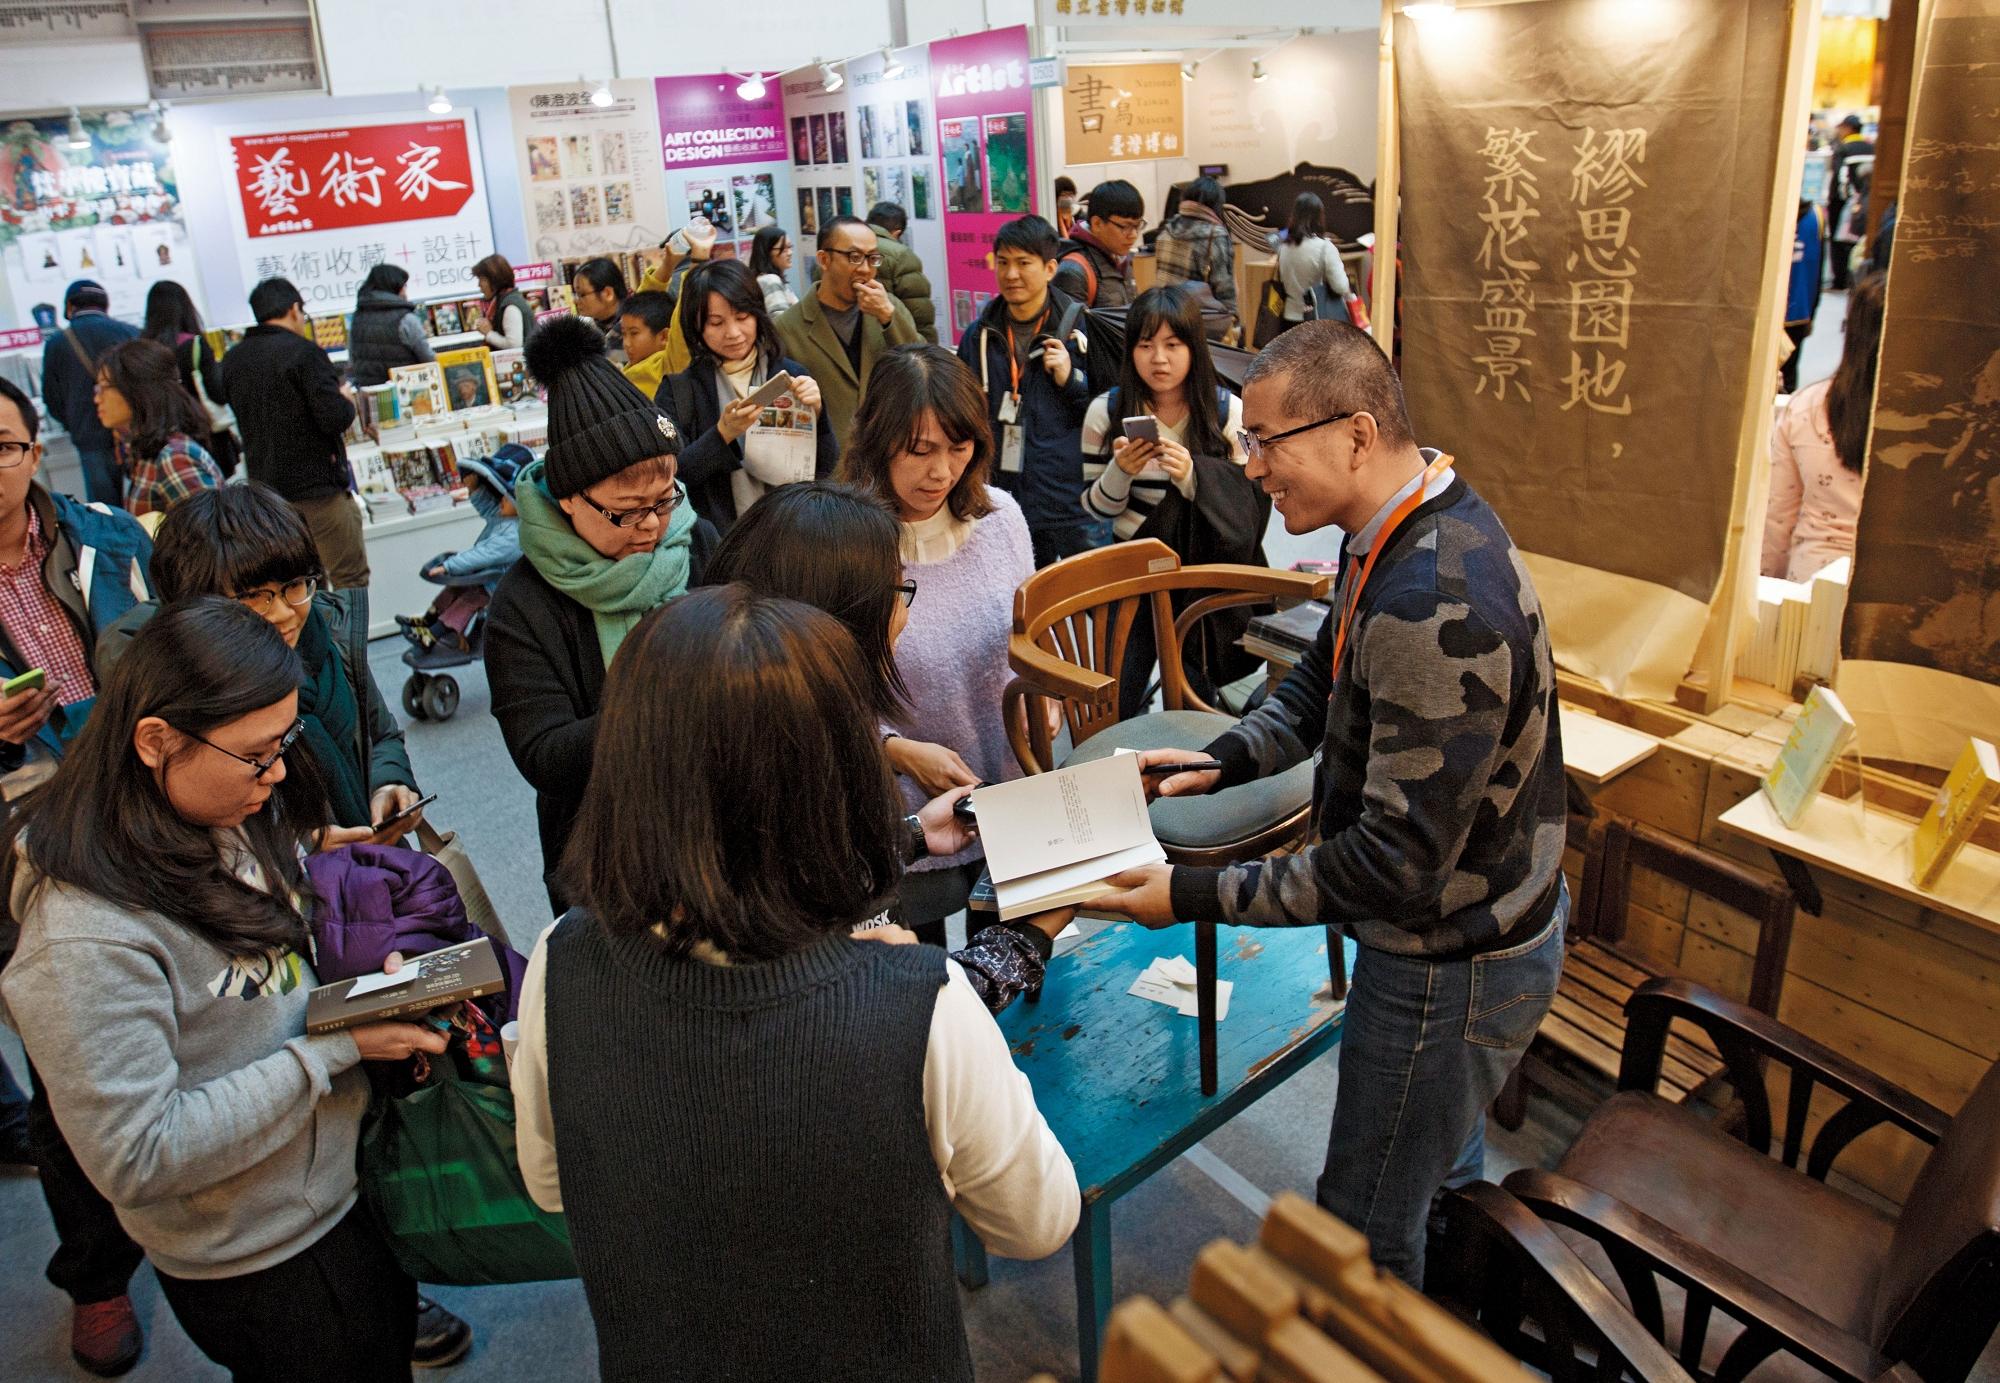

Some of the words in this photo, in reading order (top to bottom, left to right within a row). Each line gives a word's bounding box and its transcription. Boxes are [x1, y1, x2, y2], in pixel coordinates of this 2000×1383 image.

[665, 131, 692, 147] ART
[692, 126, 775, 144] COLLECTION
[665, 145, 723, 163] DESIGN
[246, 141, 469, 217] 藝術家
[1471, 126, 1547, 402] 繁花盛景
